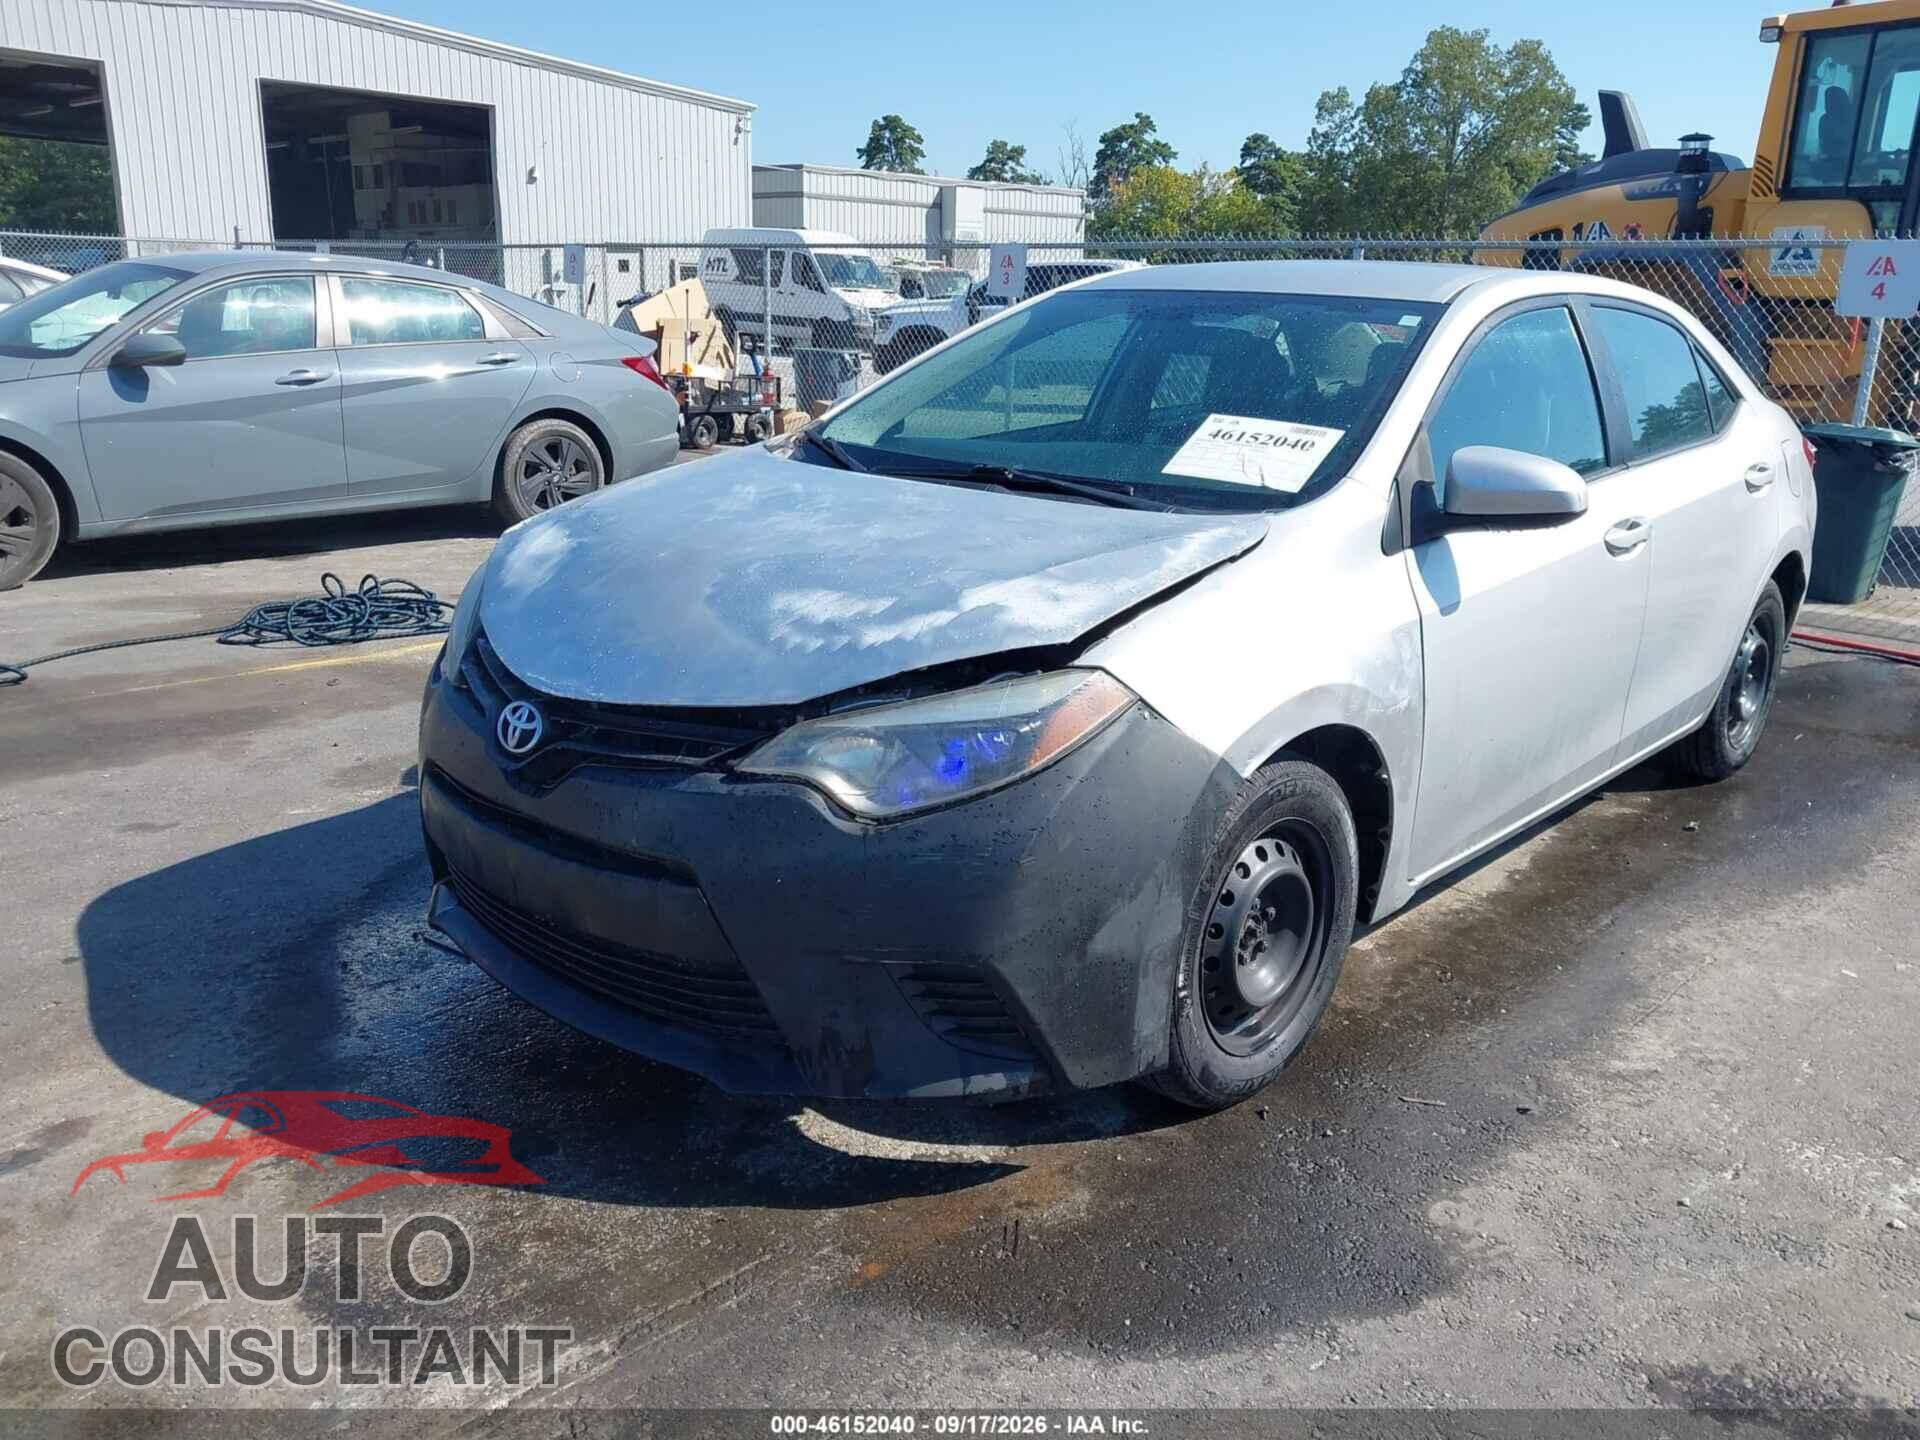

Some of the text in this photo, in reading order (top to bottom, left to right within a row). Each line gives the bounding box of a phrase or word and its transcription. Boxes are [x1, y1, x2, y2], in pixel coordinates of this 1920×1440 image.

[1003, 271, 1010, 285] 3
[1871, 282, 1886, 300] 4
[1208, 428, 1316, 452] 46152040
